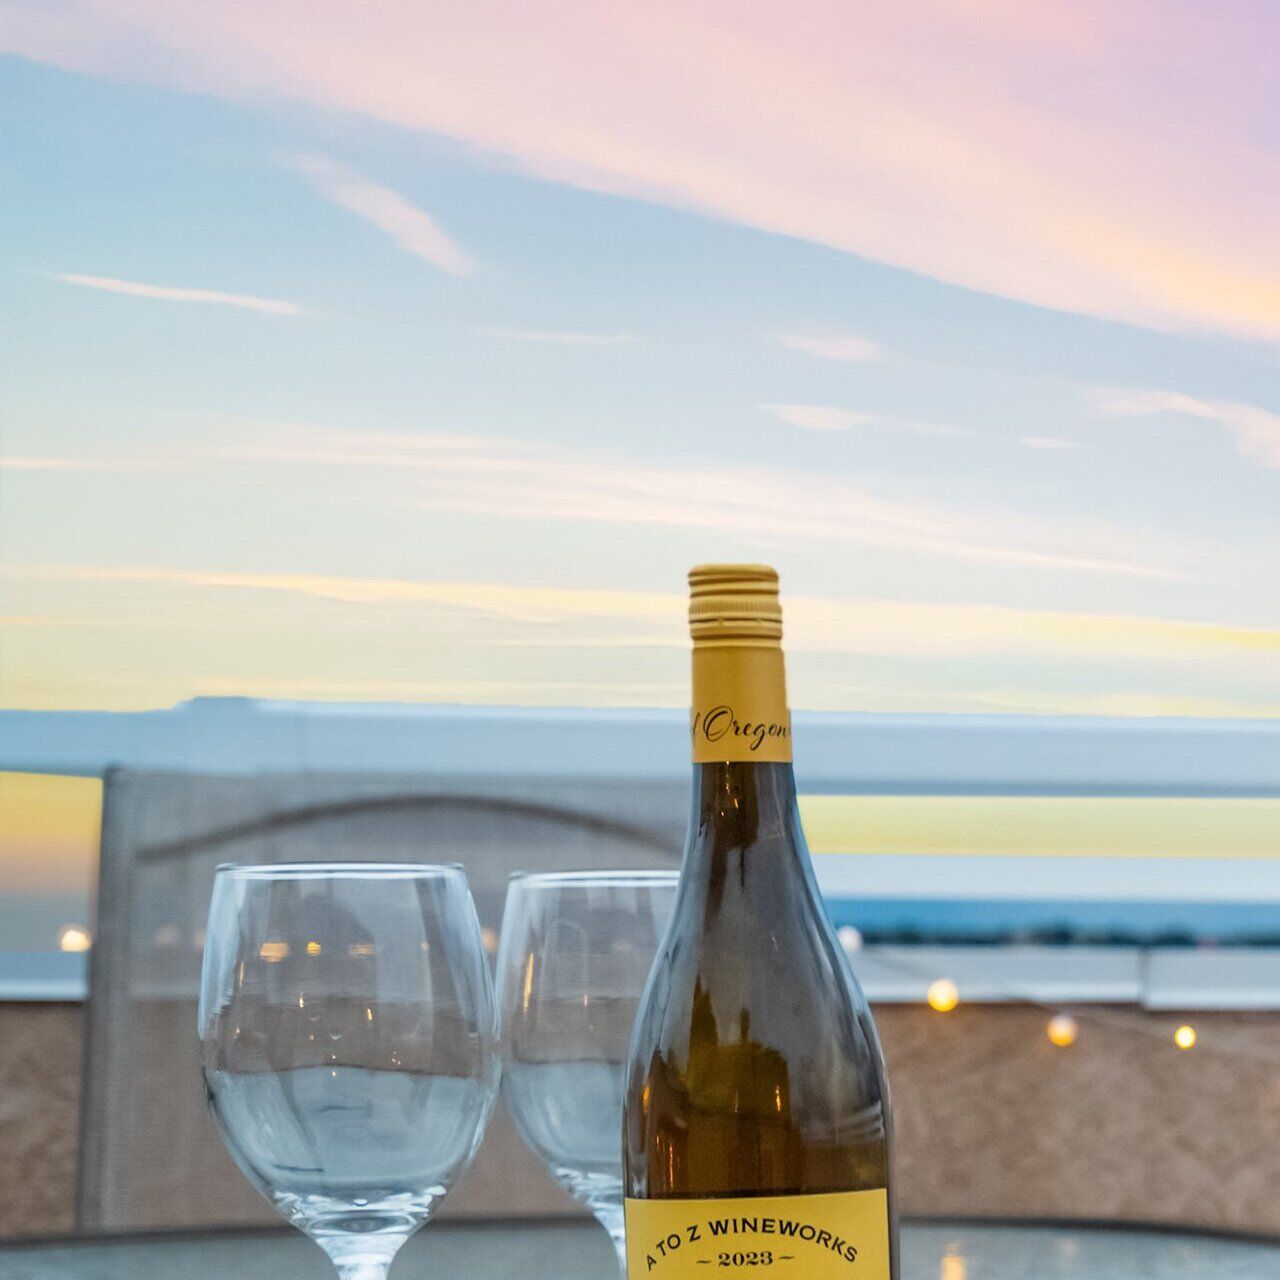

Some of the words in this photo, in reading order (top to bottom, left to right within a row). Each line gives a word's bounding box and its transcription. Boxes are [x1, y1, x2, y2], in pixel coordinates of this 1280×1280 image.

[703, 705, 787, 751] Oregon
[646, 1254, 657, 1271] A
[656, 1234, 681, 1257] TO
[686, 1224, 701, 1242] Z
[708, 1217, 858, 1263] WINEWORKS
[718, 1250, 774, 1267] 2023
